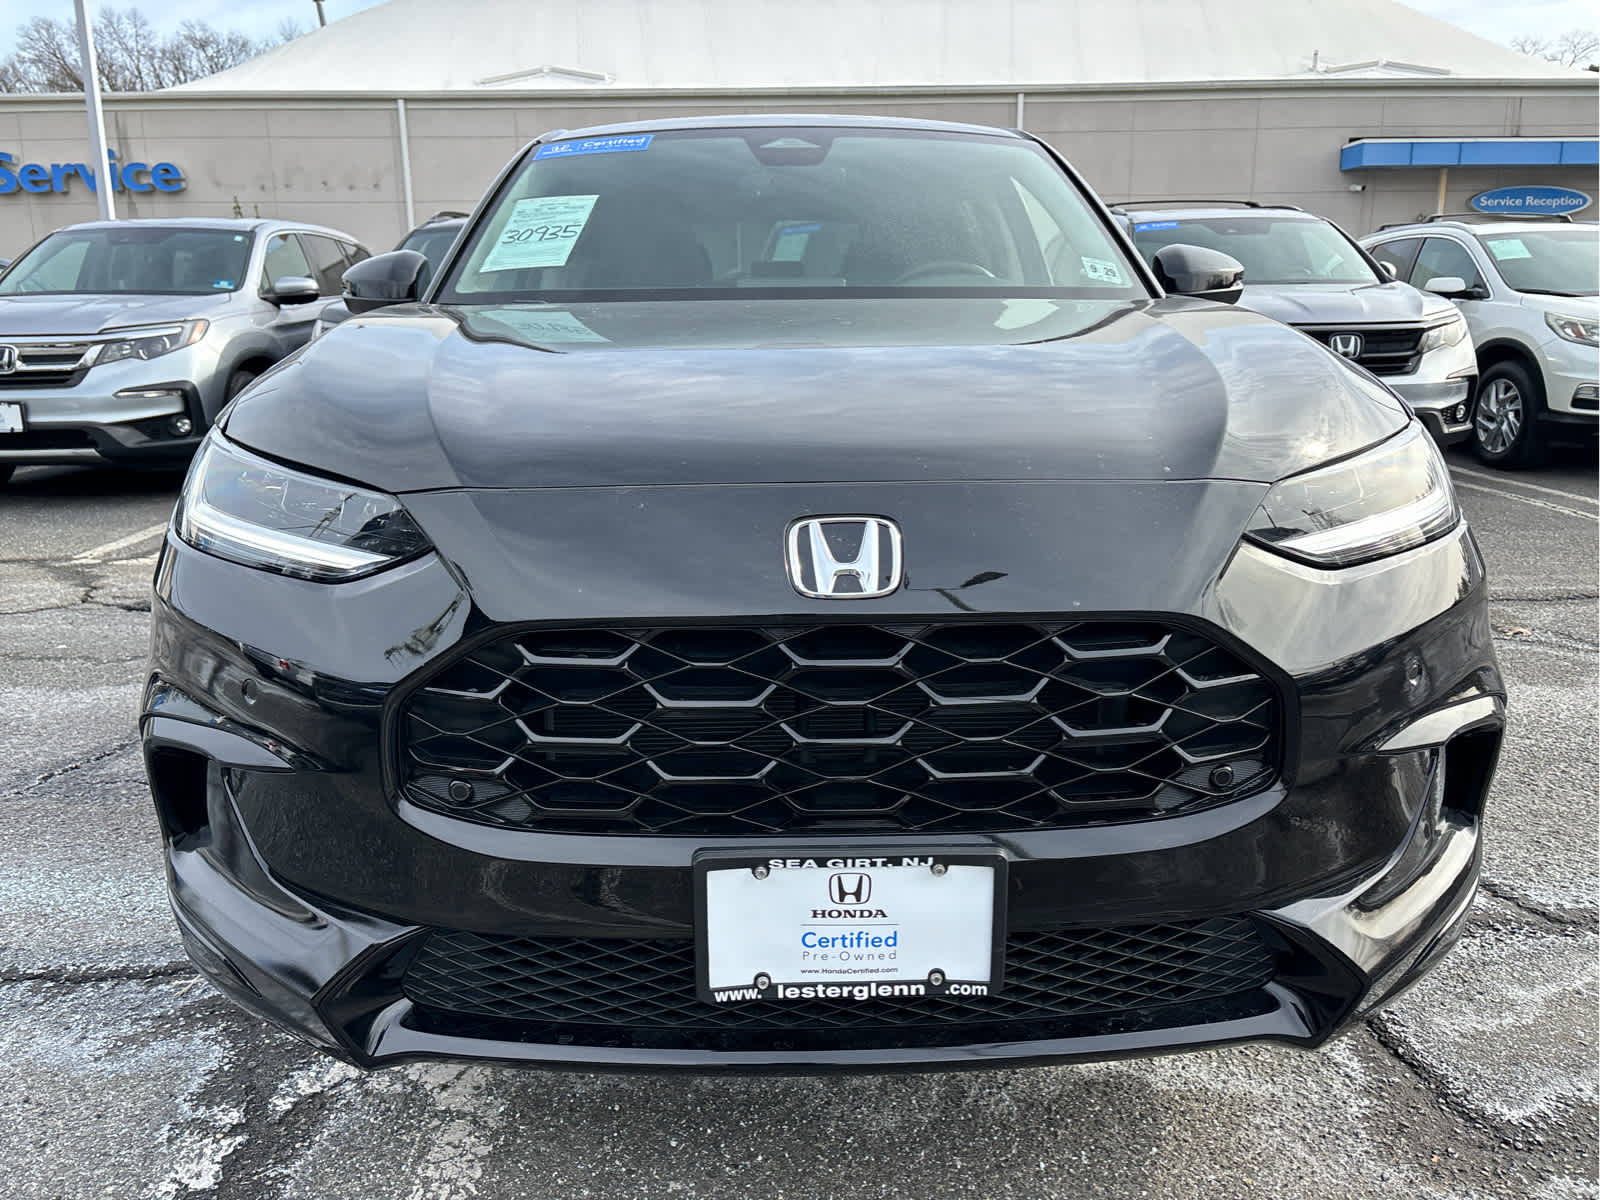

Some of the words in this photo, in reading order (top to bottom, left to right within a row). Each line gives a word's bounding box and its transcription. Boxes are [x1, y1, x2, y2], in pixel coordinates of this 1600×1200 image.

[1479, 196, 1522, 207] Service
[1525, 195, 1583, 208] Reception
[502, 224, 582, 245] 30935
[768, 858, 819, 869] SEA
[902, 857, 934, 867] NJ
[811, 909, 888, 918] HONDA
[801, 930, 898, 948] Certified
[802, 950, 897, 961] Pre-Owned
[800, 967, 898, 975] www.HondaCertified.com
[714, 987, 762, 1002] www.
[777, 982, 926, 1000] lesterglenn
[944, 984, 988, 996] .com
